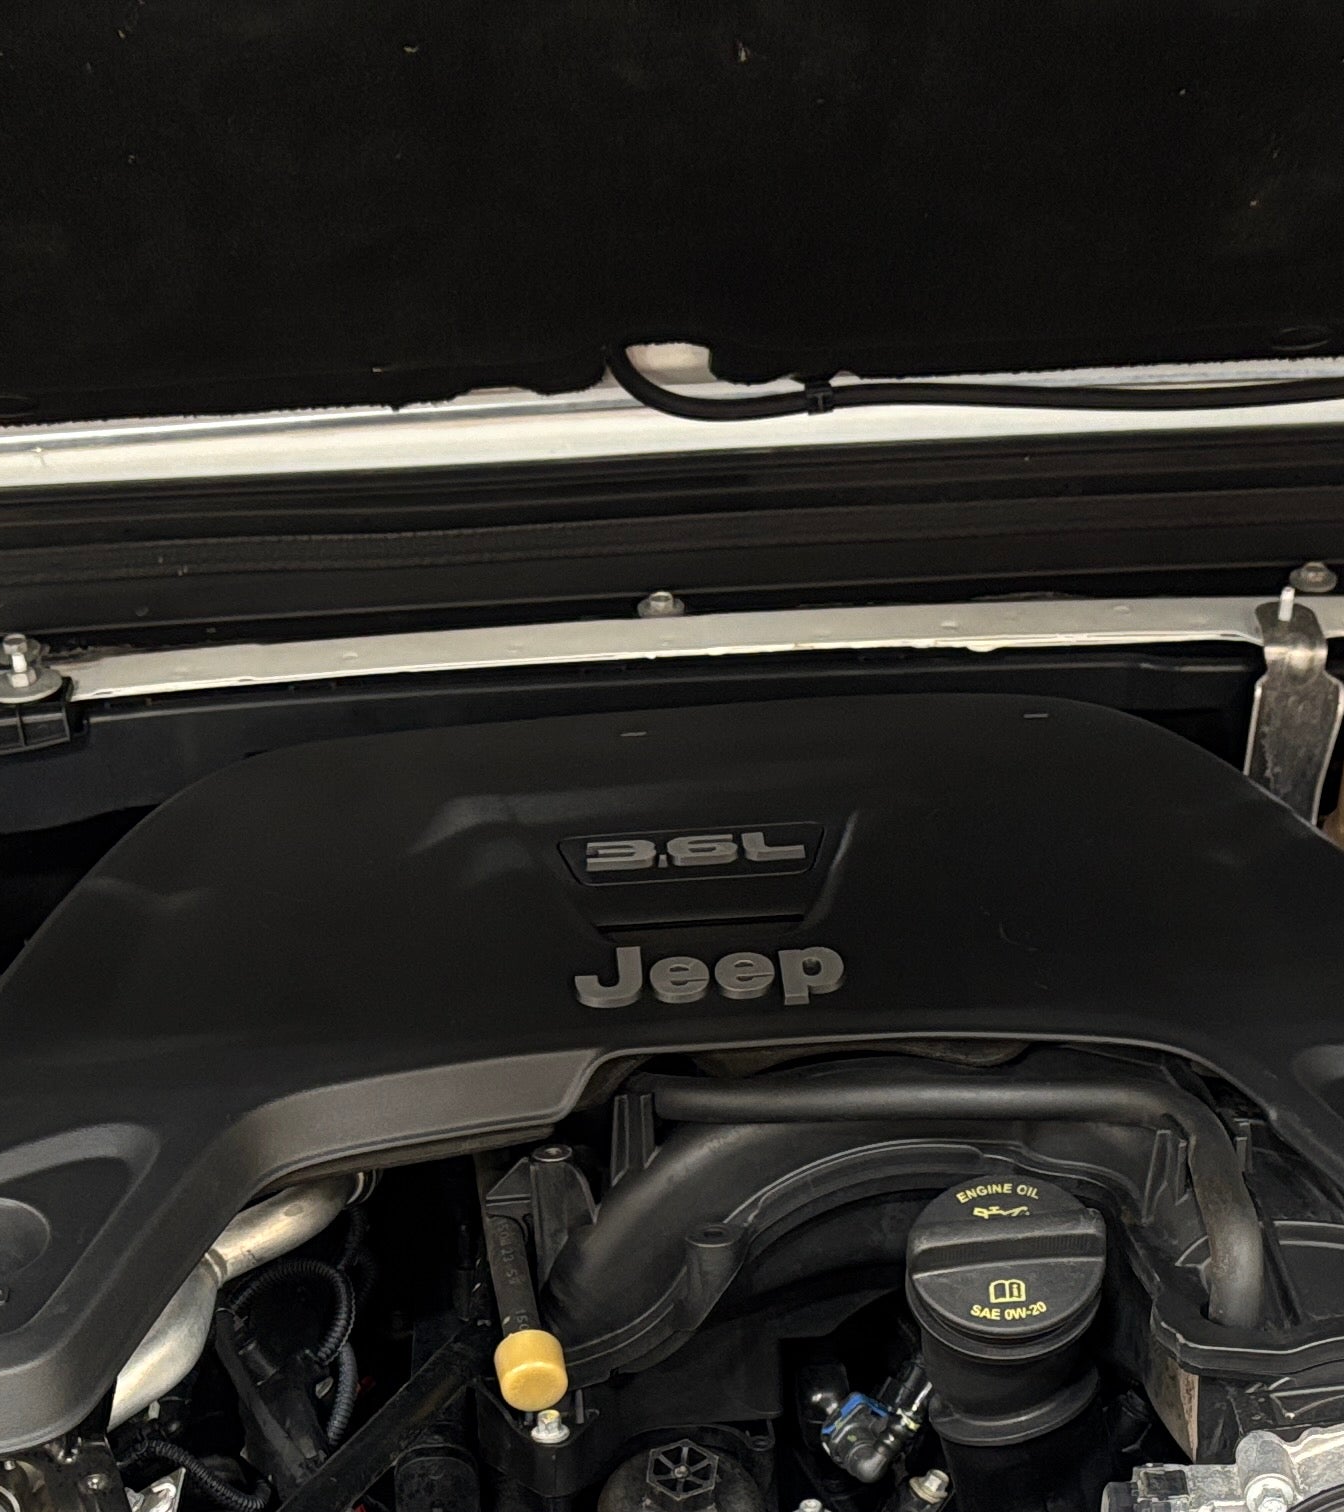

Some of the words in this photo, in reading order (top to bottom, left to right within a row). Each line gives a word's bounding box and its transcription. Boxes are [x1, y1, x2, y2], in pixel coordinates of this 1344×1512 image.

[586, 832, 806, 872] 3.6L
[574, 946, 845, 1009] Jeep
[956, 1183, 1012, 1203] ENGINE
[1017, 1185, 1039, 1199] OIL
[970, 1304, 1000, 1320] SAE
[1005, 1302, 1047, 1319] 0W-20
